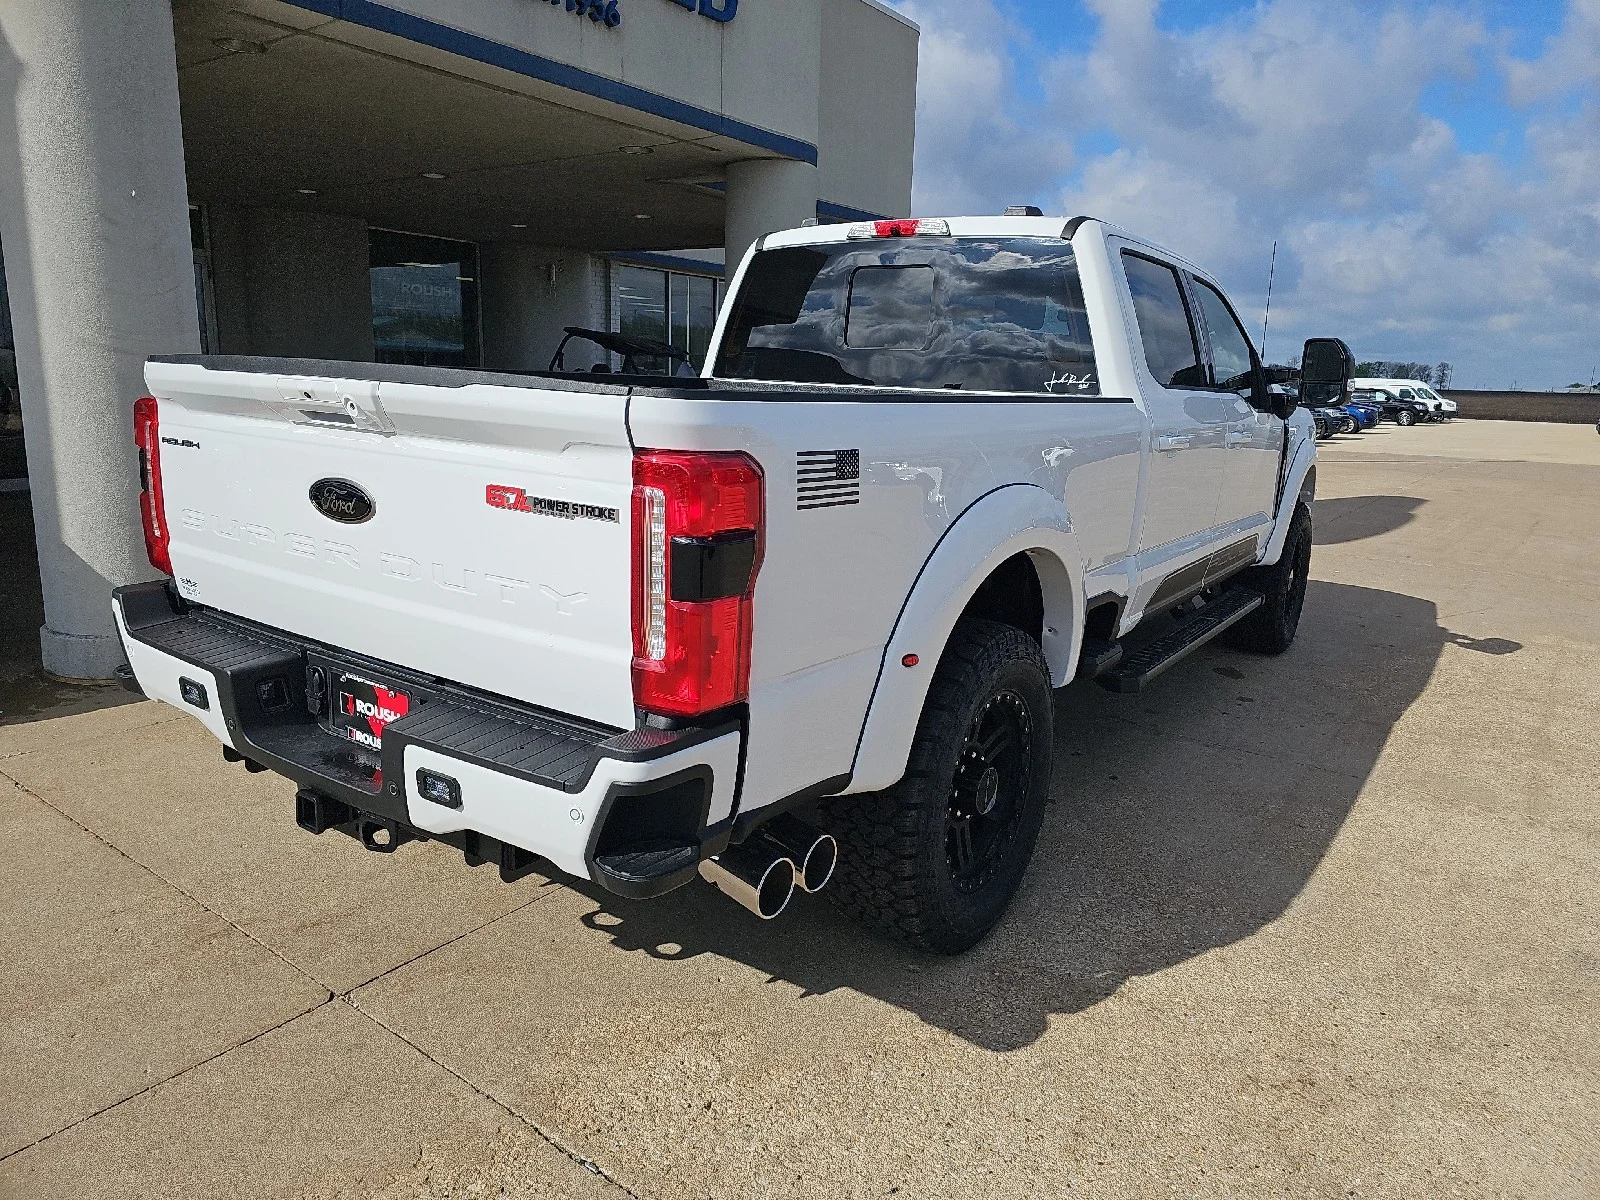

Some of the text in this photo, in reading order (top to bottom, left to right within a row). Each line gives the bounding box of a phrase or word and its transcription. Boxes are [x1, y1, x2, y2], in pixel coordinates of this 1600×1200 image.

[401, 282, 453, 298] ROUSH
[322, 486, 357, 514] Ford
[533, 497, 570, 514] POWER
[571, 503, 616, 521] STROKE
[181, 507, 588, 616] SUPER DUTY
[355, 730, 382, 750] ROUS
